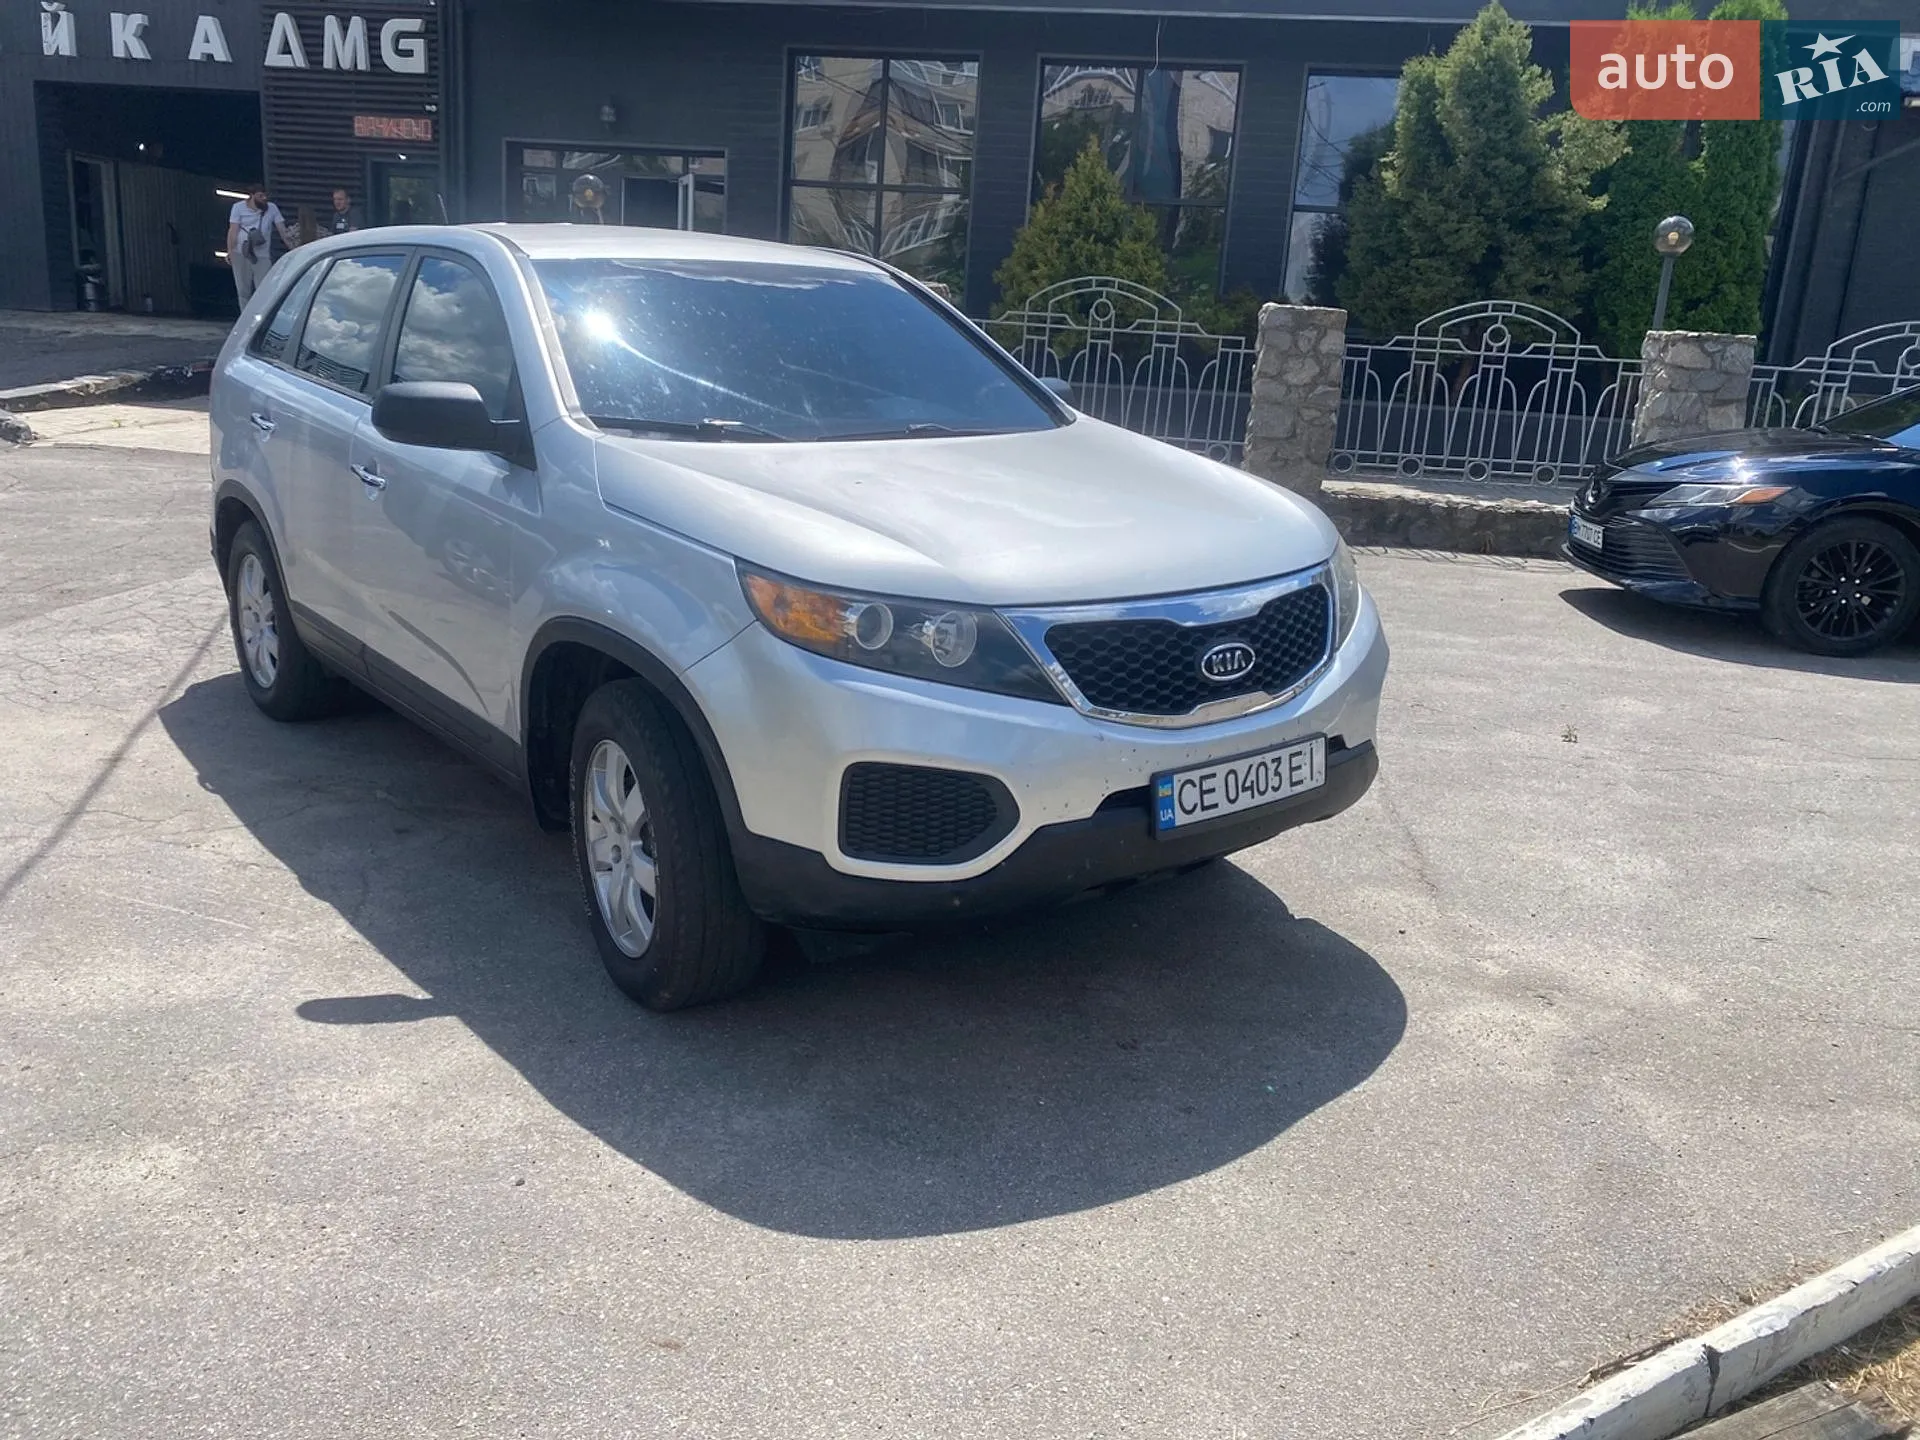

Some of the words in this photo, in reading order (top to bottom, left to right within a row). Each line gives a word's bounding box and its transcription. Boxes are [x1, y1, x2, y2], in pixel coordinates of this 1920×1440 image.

[263, 12, 428, 73] AMG
[1211, 650, 1246, 674] KIA
[1178, 772, 1219, 815] CE
[1224, 756, 1283, 805] 0403
[1159, 808, 1175, 822] UA
